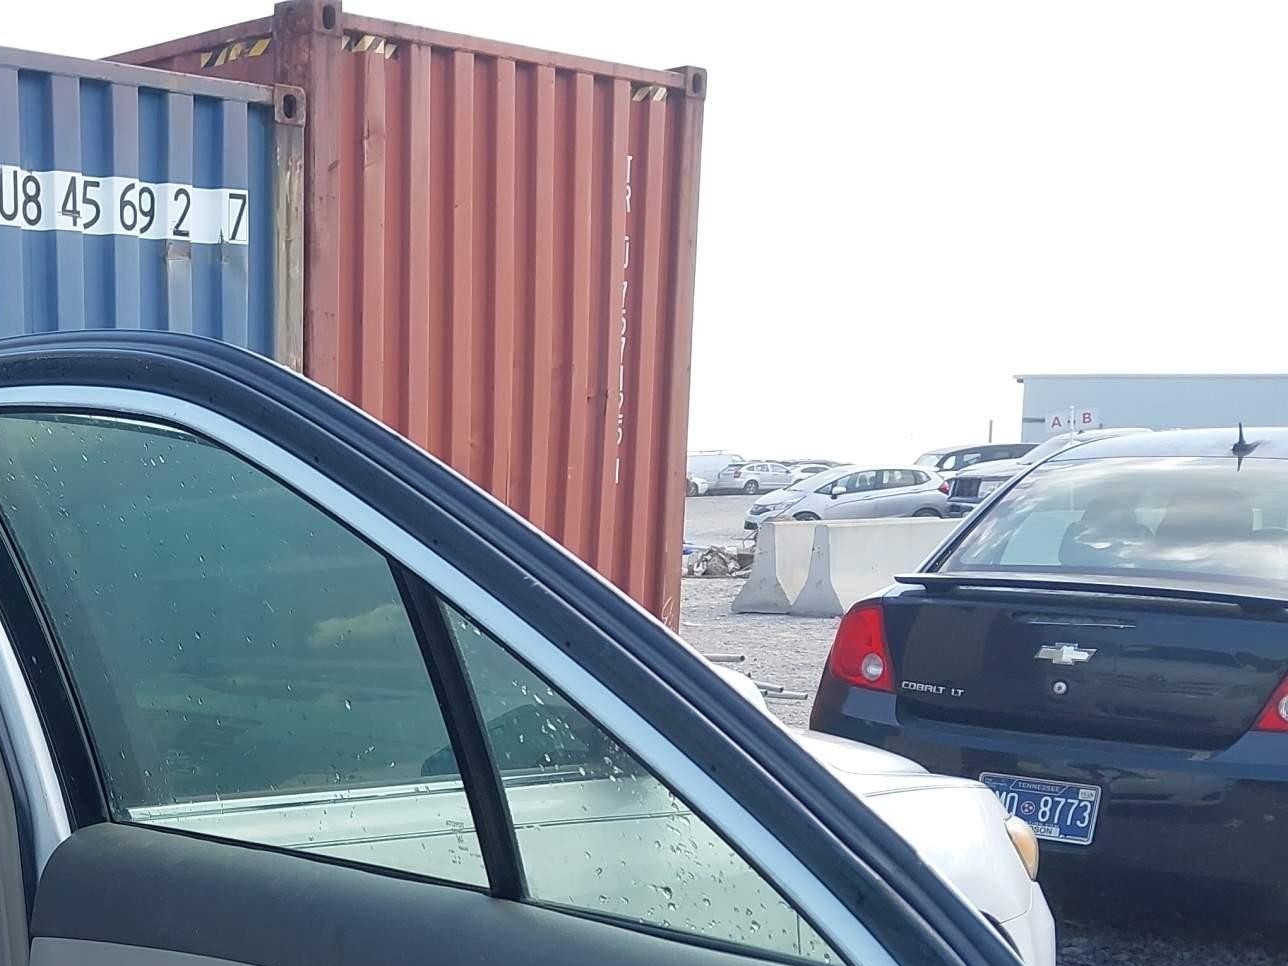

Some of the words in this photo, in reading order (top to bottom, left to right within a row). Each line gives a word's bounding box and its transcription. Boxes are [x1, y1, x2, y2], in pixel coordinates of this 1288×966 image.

[1051, 416, 1062, 428] A
[1082, 412, 1092, 424] B
[902, 681, 946, 694] COBALT
[951, 688, 965, 697] LT
[1037, 796, 1092, 828] 8773
